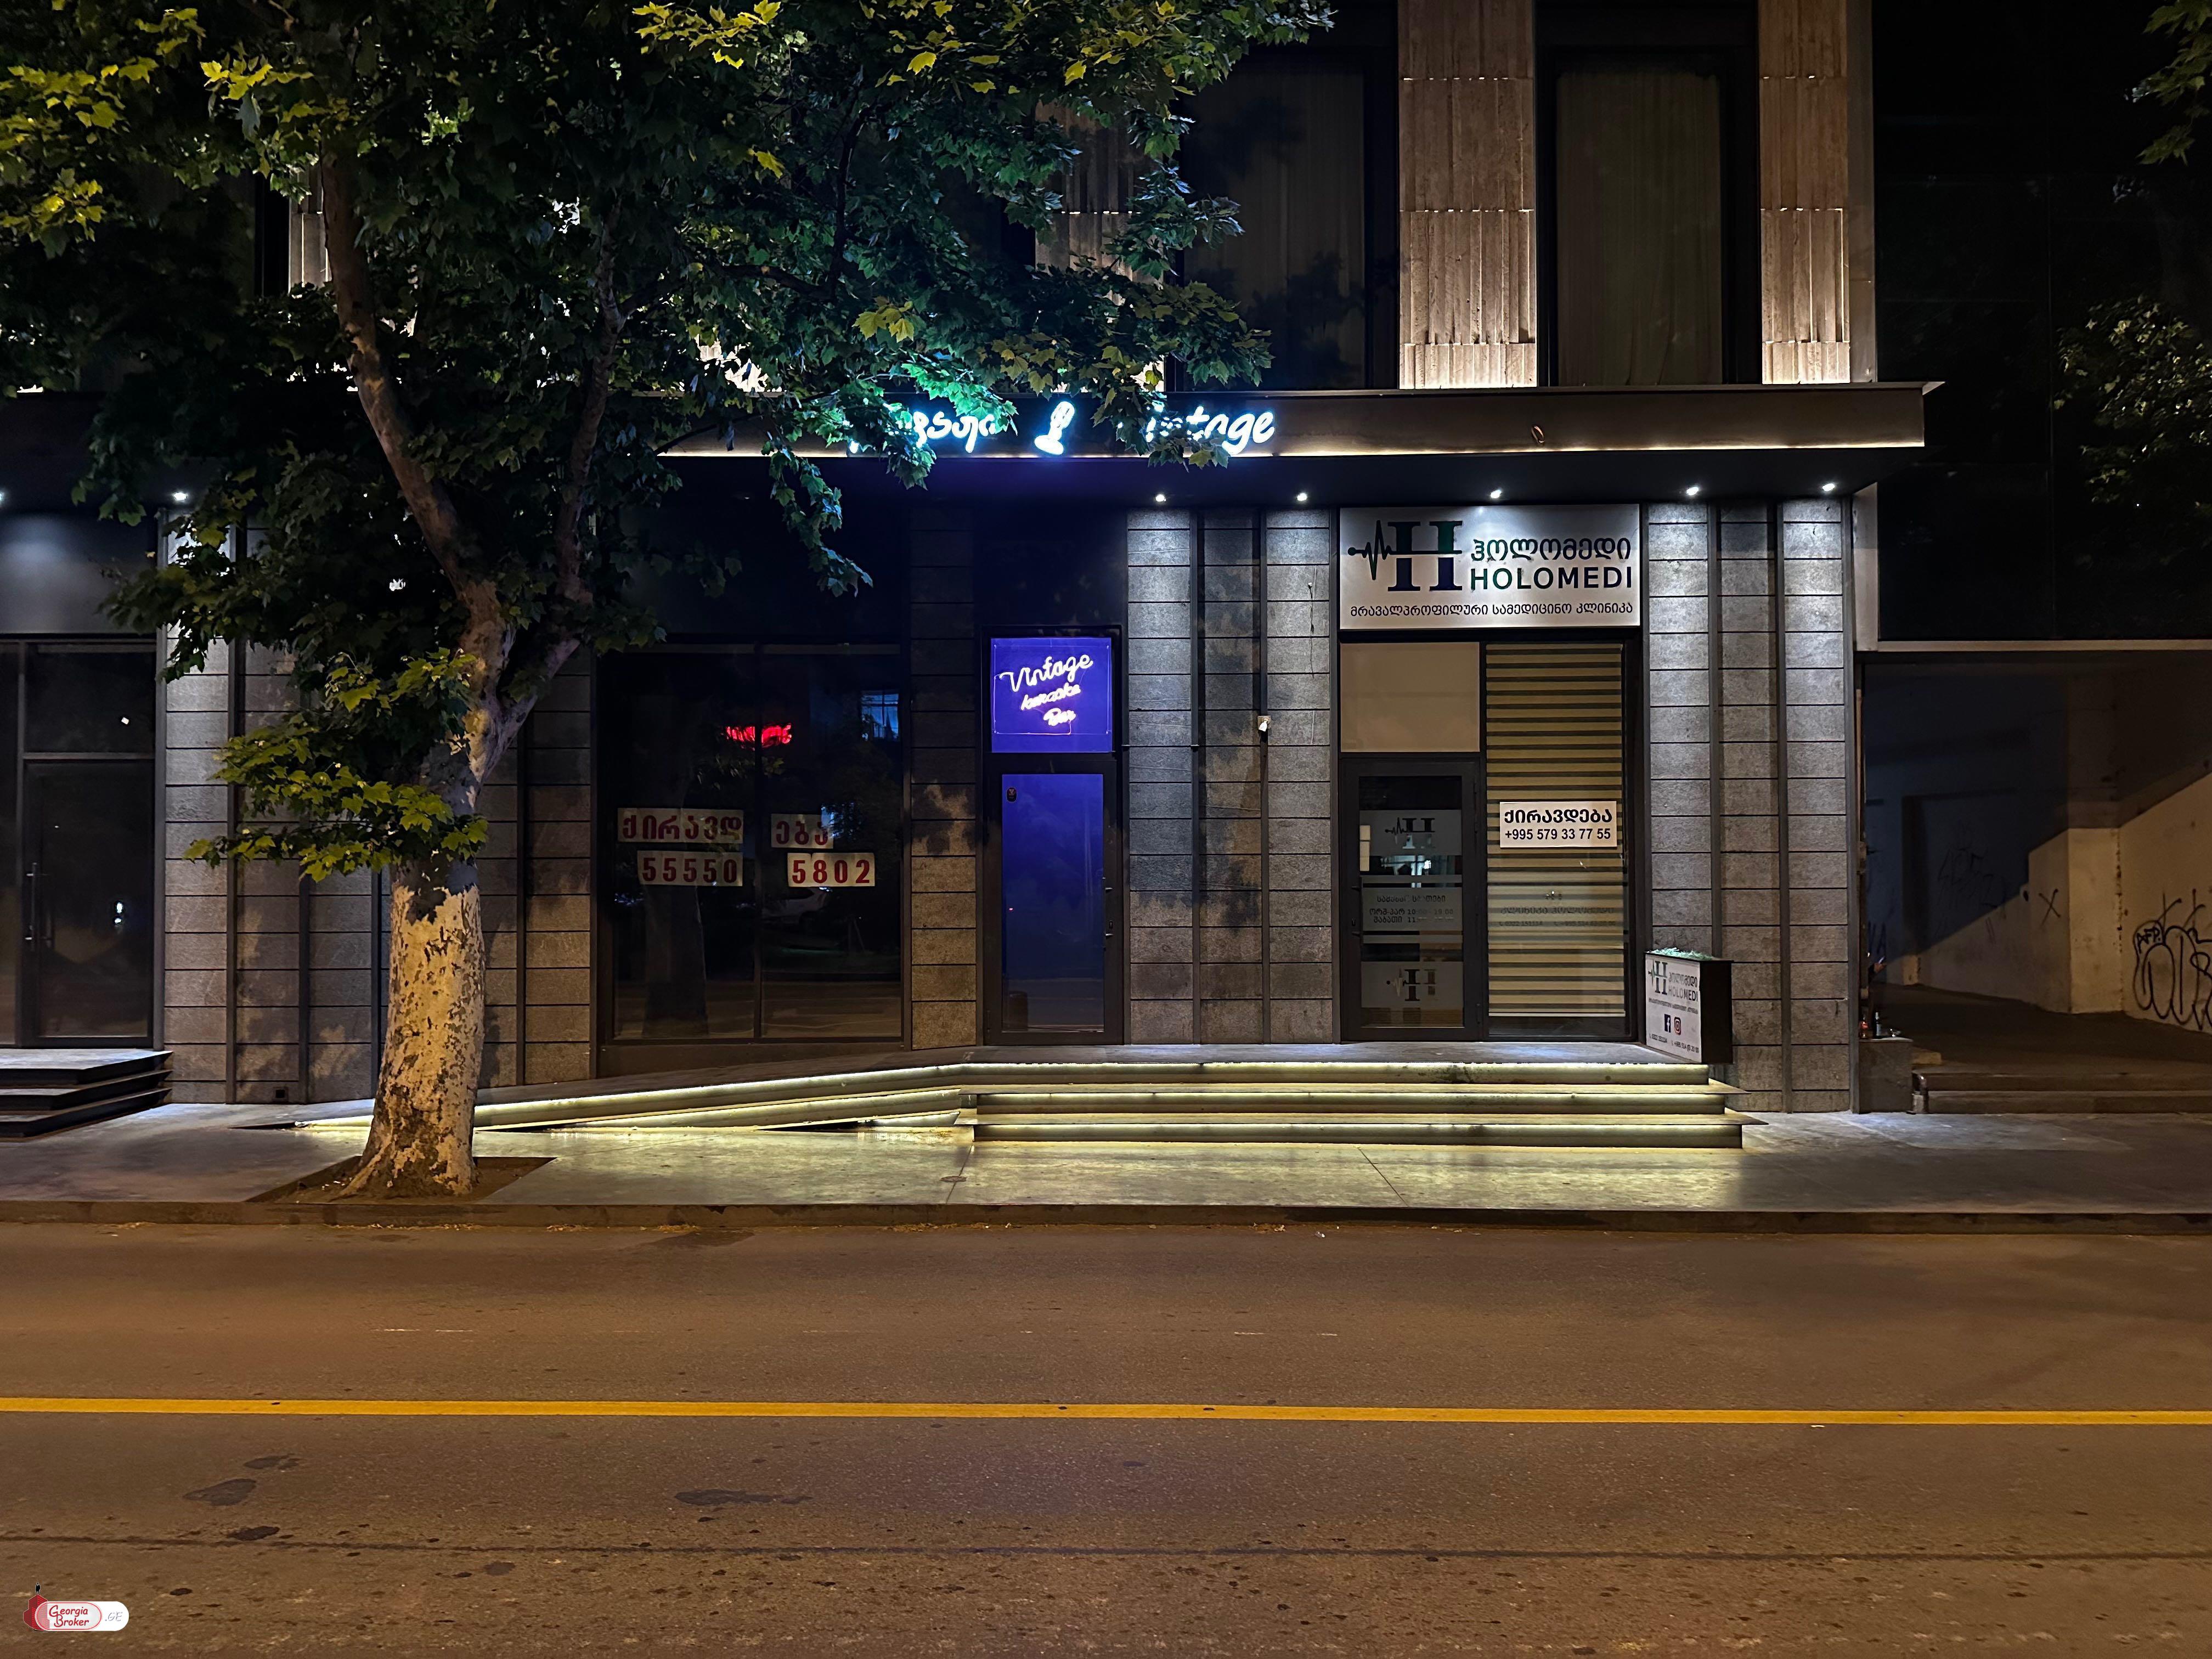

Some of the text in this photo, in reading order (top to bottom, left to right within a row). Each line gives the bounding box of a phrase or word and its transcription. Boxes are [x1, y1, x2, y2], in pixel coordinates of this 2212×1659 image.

[1471, 538, 1631, 562] ჰოლომედი
[1471, 566, 1632, 590] HOLOMEDI
[1351, 602, 1633, 617] მრავალპროფილური სამედიცინო კლინიკა
[1504, 809, 1612, 823] ქირავდება
[1505, 828, 1611, 840] +995 579 33 77 55
[642, 857, 870, 884] 55550 5802
[1668, 985, 1699, 1002] HOLOMEDI
